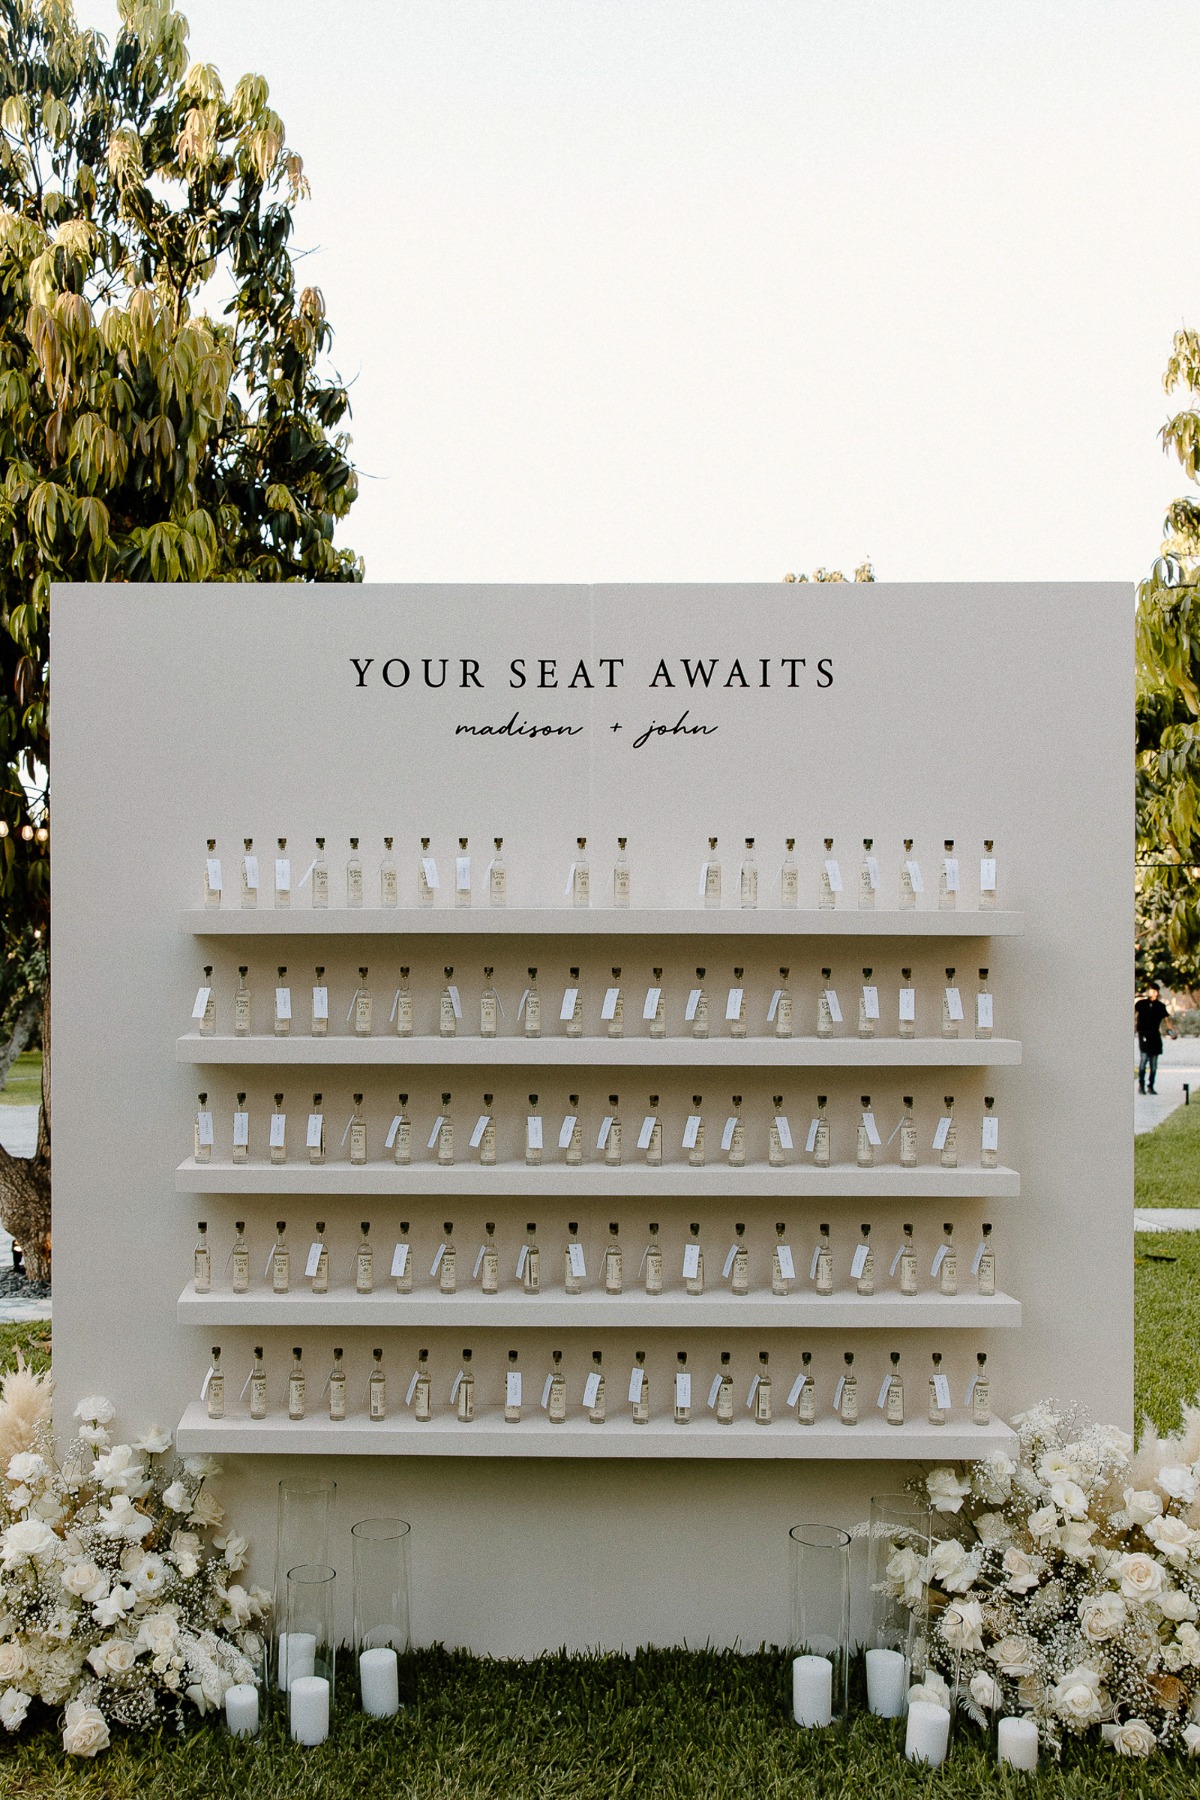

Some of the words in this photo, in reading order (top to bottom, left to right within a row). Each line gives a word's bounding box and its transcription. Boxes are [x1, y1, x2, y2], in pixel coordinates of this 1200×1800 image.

[350, 658, 485, 689] YOUR
[509, 658, 624, 689] SEAT
[648, 658, 834, 689] AWAITS
[455, 711, 584, 739] madison
[610, 722, 623, 733] +
[632, 710, 719, 749] john
